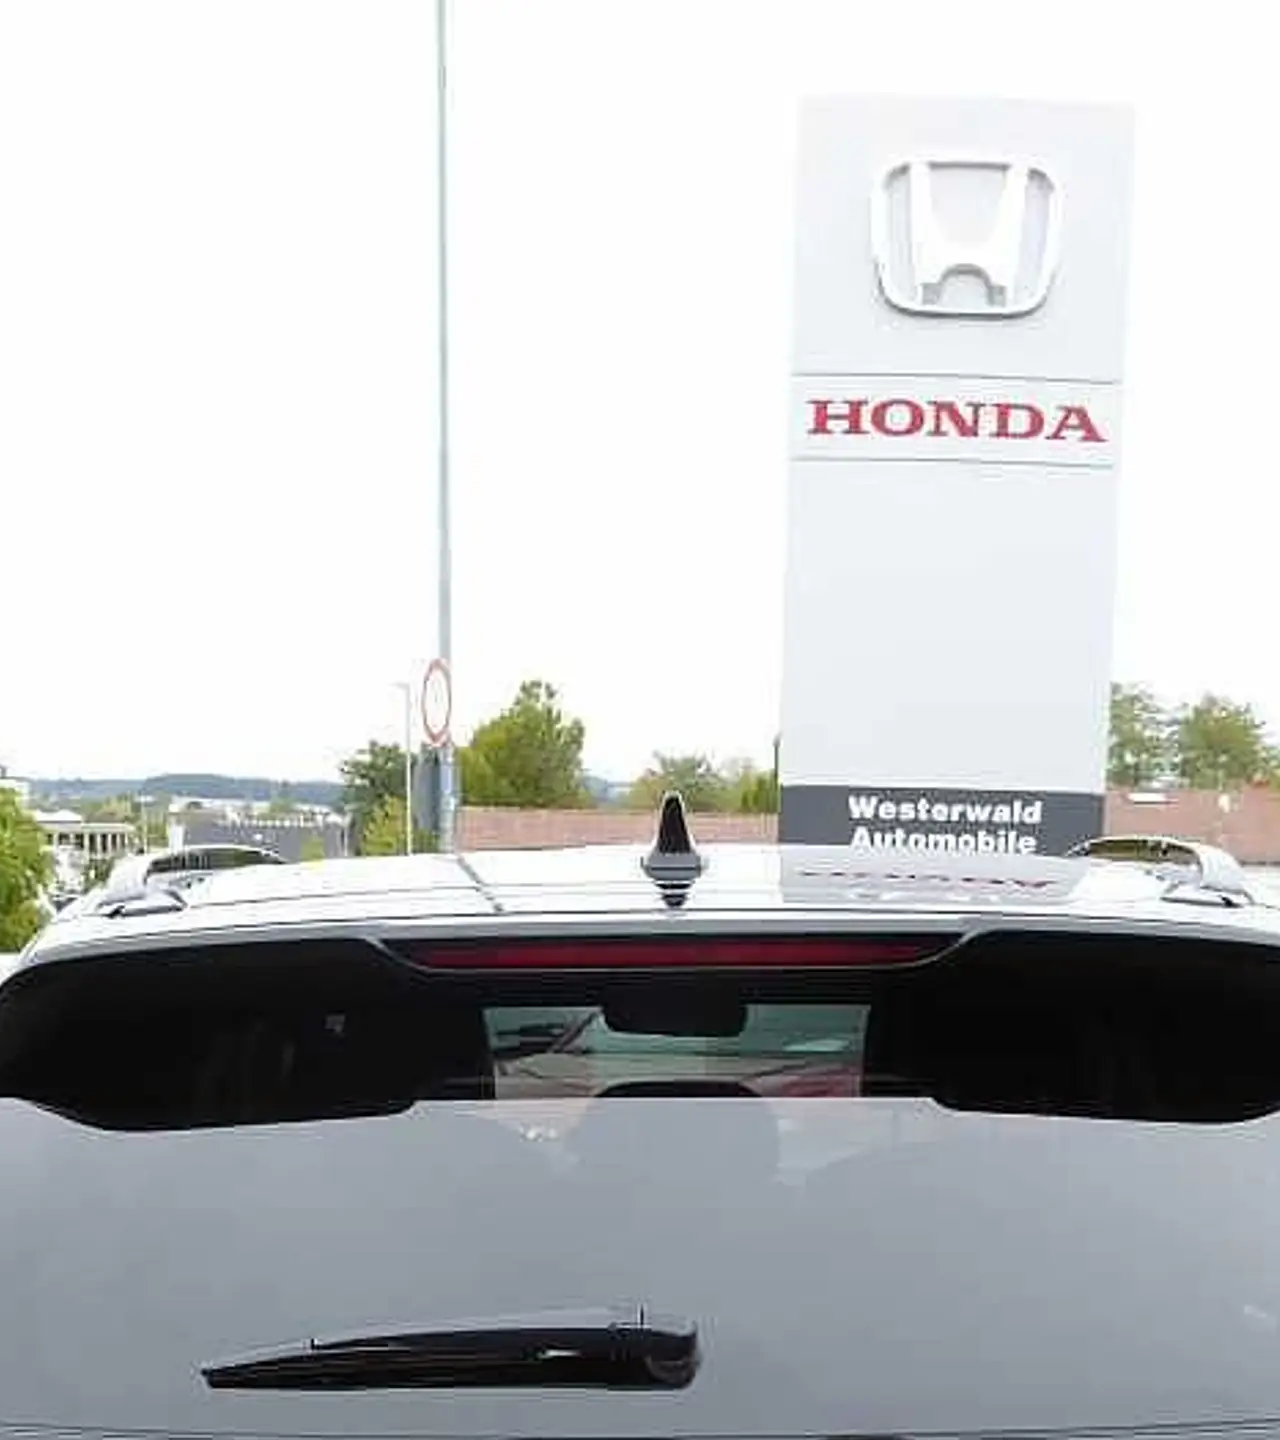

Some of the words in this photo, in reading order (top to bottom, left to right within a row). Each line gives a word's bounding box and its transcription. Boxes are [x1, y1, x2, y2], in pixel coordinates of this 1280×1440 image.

[806, 398, 1109, 442] HONDA
[847, 795, 1043, 824] Westerwald
[850, 826, 1037, 854] Automobile
